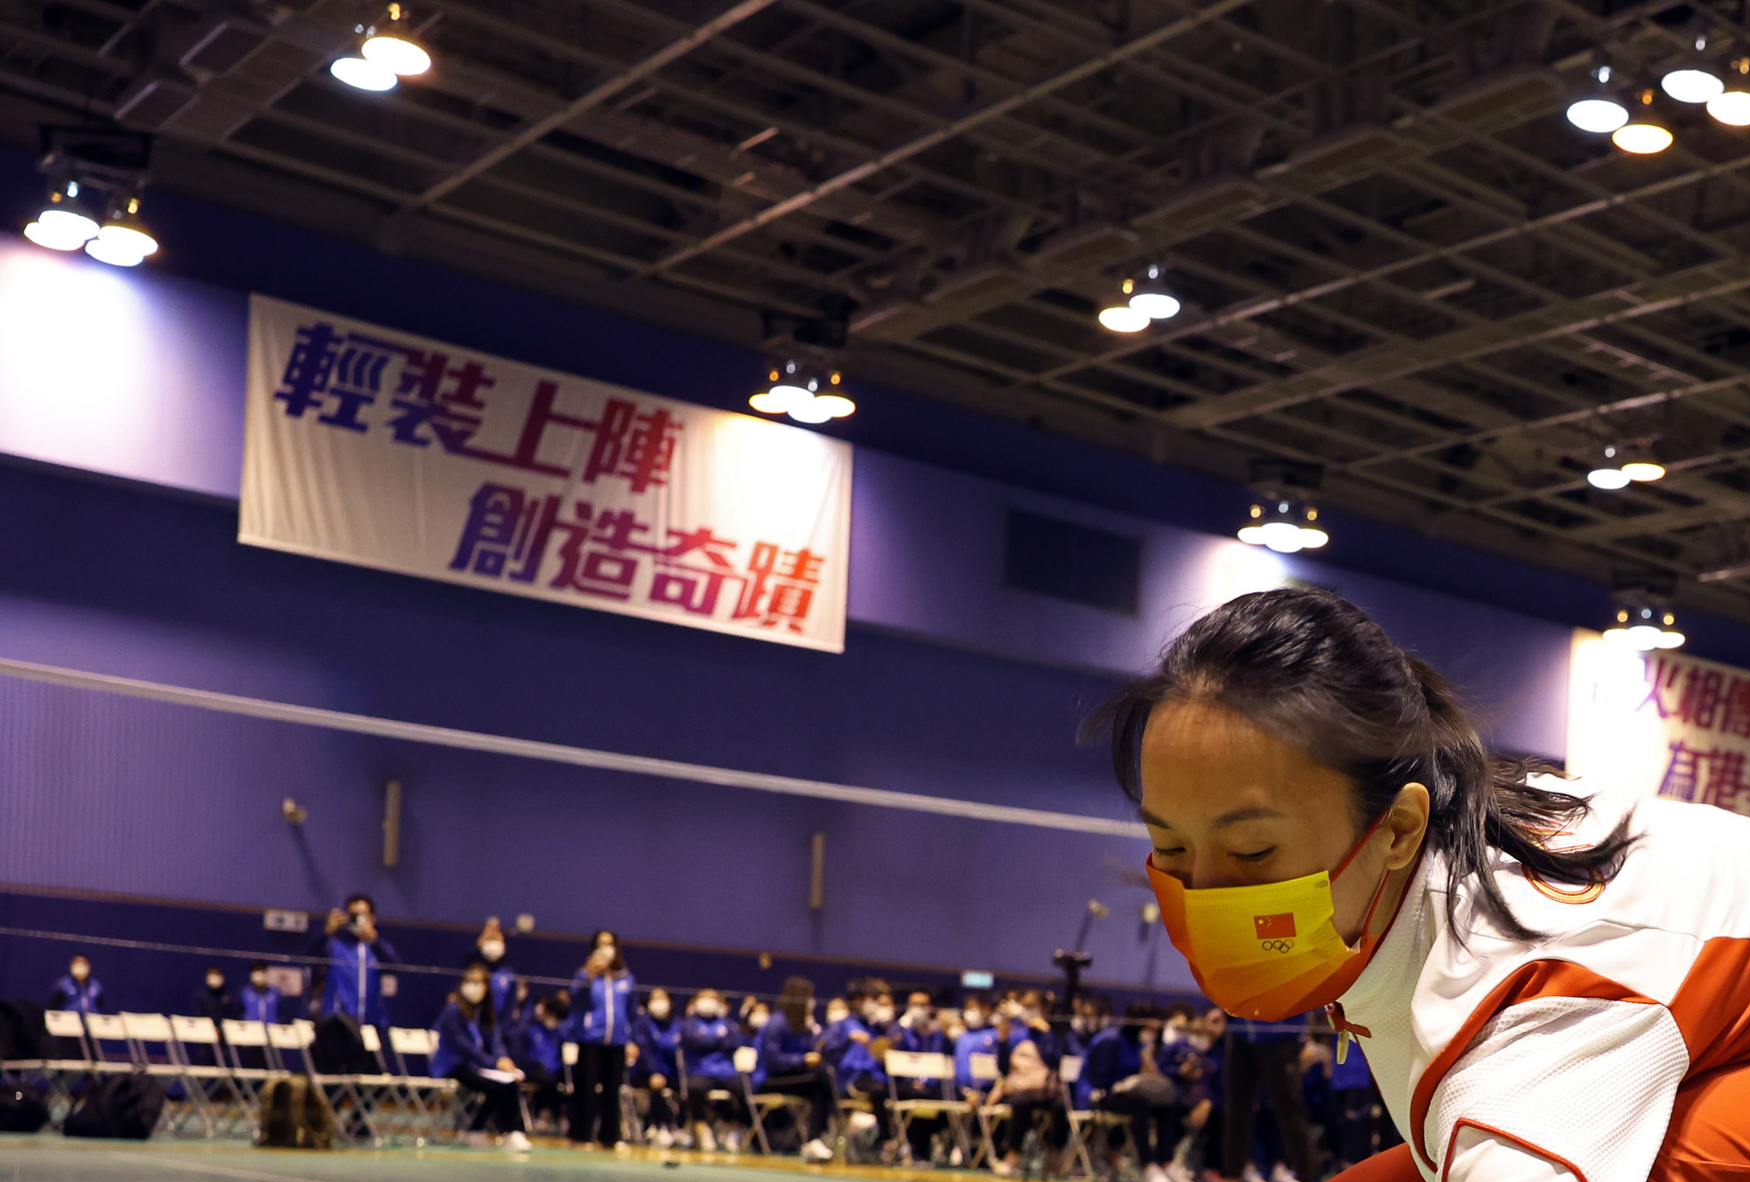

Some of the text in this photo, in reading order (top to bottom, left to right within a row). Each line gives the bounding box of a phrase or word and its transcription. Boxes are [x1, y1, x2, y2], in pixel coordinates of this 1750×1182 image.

[275, 322, 684, 494] 輕裝上陣
[448, 481, 826, 633] 創造奇蹟
